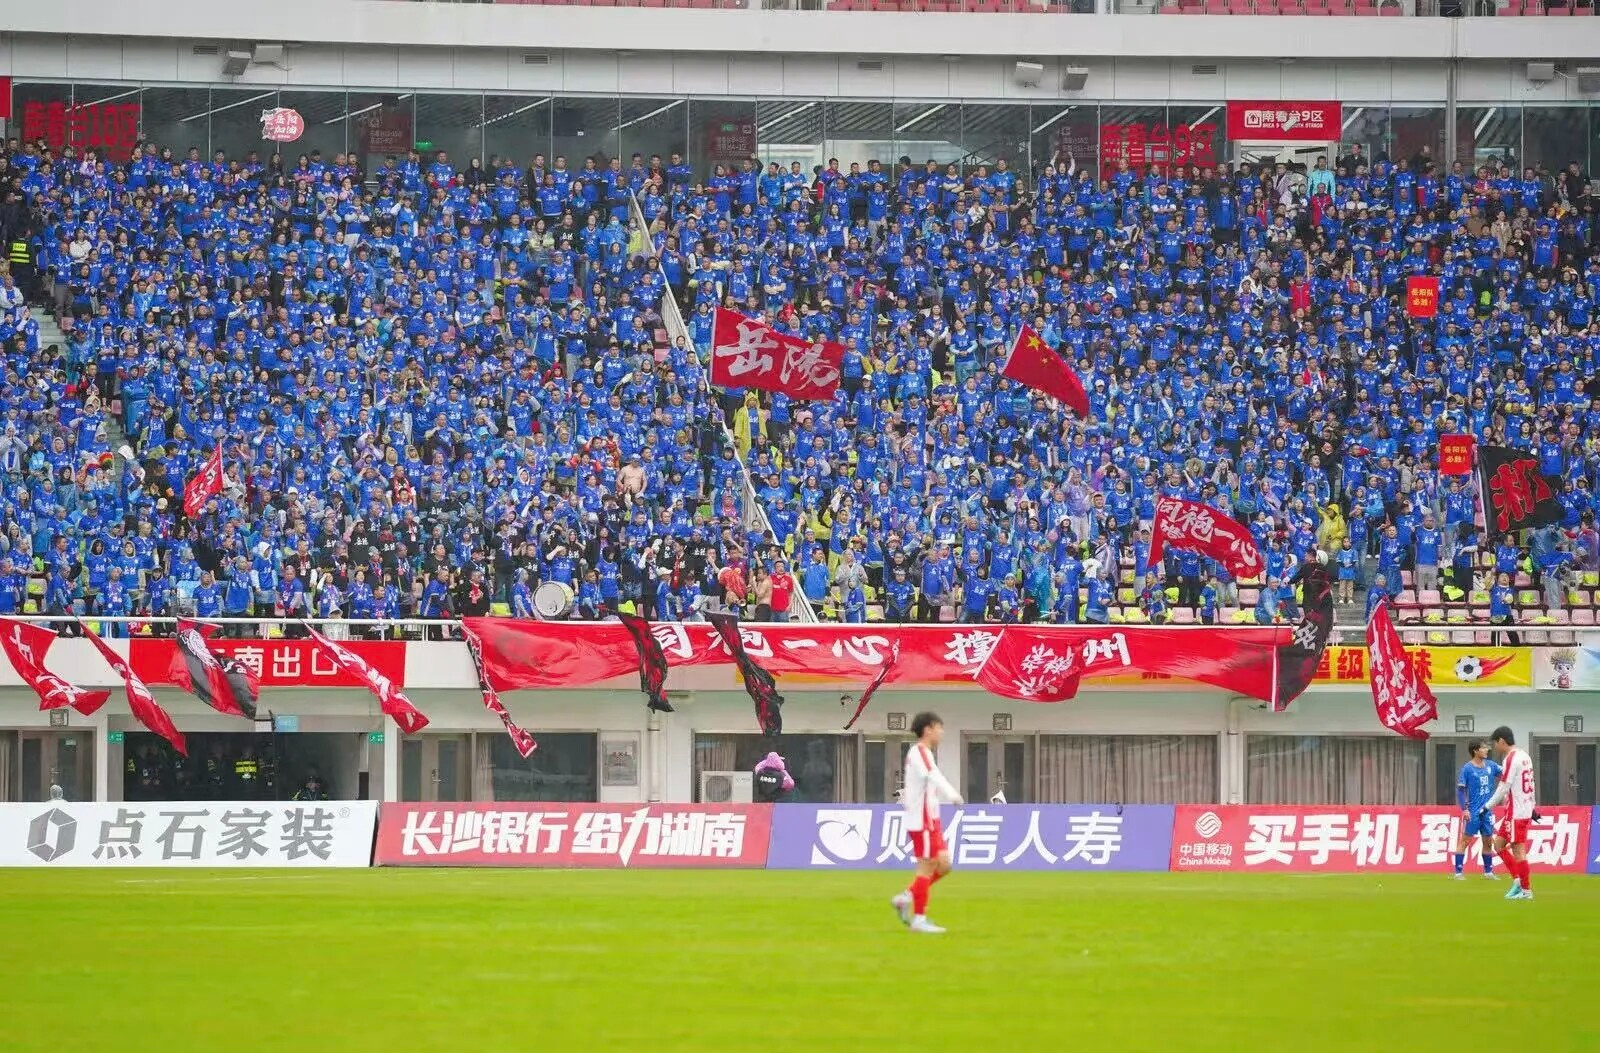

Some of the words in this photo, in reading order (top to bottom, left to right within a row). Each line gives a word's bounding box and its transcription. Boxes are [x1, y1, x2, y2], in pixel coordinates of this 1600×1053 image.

[1262, 110, 1323, 122] 南看台9区
[1411, 288, 1433, 297] 岳阳队
[1443, 446, 1467, 454] 岳阳队
[1160, 501, 1257, 567] 同袍一心
[91, 807, 335, 860] 点石家装
[402, 810, 568, 855] 长沙银行
[571, 806, 746, 867] 给力湖南
[1244, 813, 1404, 866] 买手机
[1180, 843, 1232, 856] 中国移动
[1179, 857, 1203, 866] China
[1204, 857, 1231, 866] Mobile
